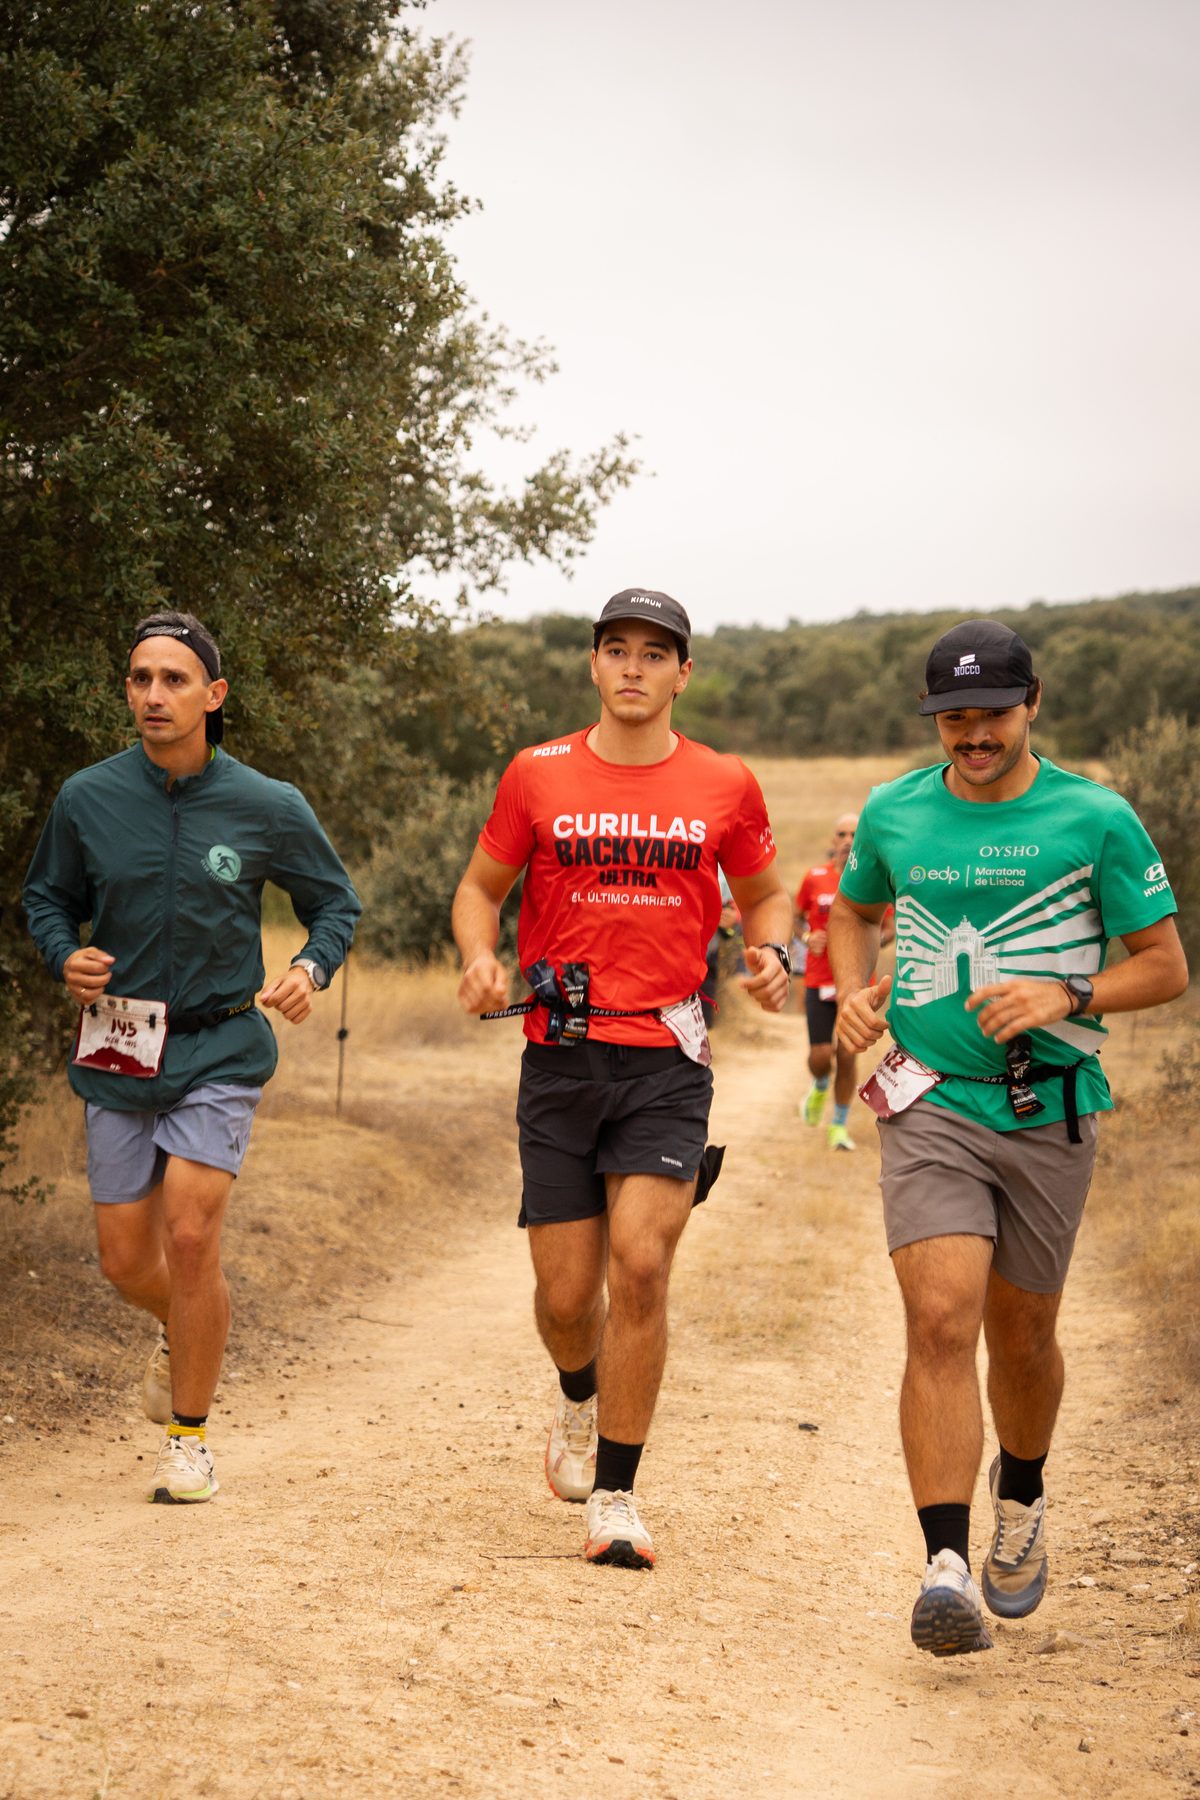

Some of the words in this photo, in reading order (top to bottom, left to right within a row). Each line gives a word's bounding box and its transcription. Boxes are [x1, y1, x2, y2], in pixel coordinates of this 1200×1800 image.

[630, 596, 662, 609] KIPRUN
[954, 665, 980, 677] NOCCO
[553, 813, 707, 844] CURILLAS
[554, 837, 703, 871] BACKYARD
[979, 845, 1040, 858] OYSHO
[600, 868, 658, 888] ULTRA
[928, 865, 960, 885] edp
[975, 867, 1027, 877] Maratona
[974, 877, 988, 886] de
[989, 877, 1025, 887] Lisboa
[571, 891, 585, 904] EL
[587, 889, 630, 905] ÚLTIMO
[631, 894, 682, 907] ARRIERO
[110, 1017, 138, 1038] 145
